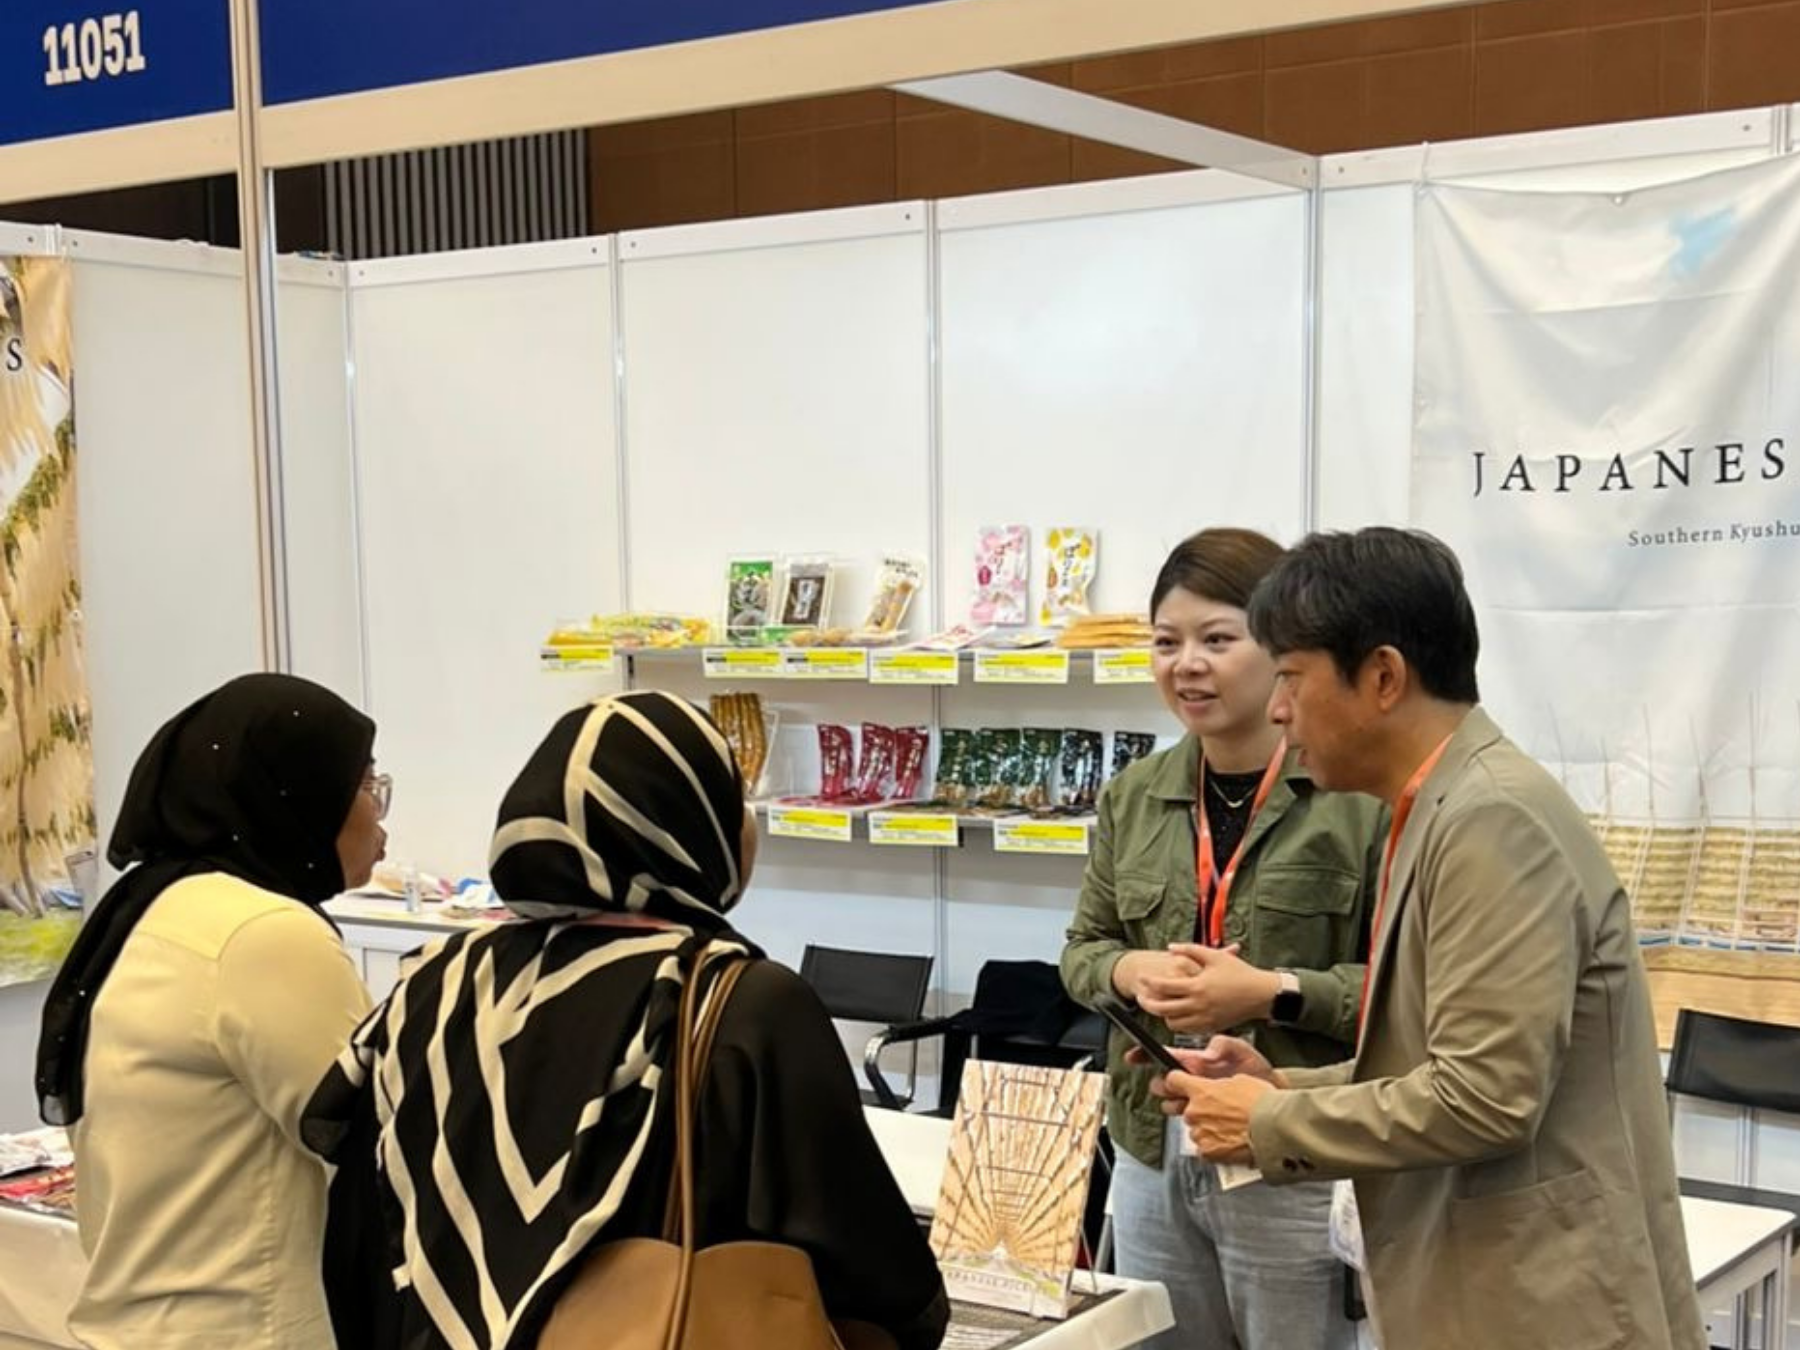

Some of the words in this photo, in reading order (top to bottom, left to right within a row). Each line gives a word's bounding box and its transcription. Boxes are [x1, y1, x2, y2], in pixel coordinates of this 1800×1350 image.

[43, 10, 145, 85] 11051
[1473, 438, 1785, 497] JAPANES
[1628, 527, 1723, 547] Southern
[1730, 520, 1800, 543] Kyushu
